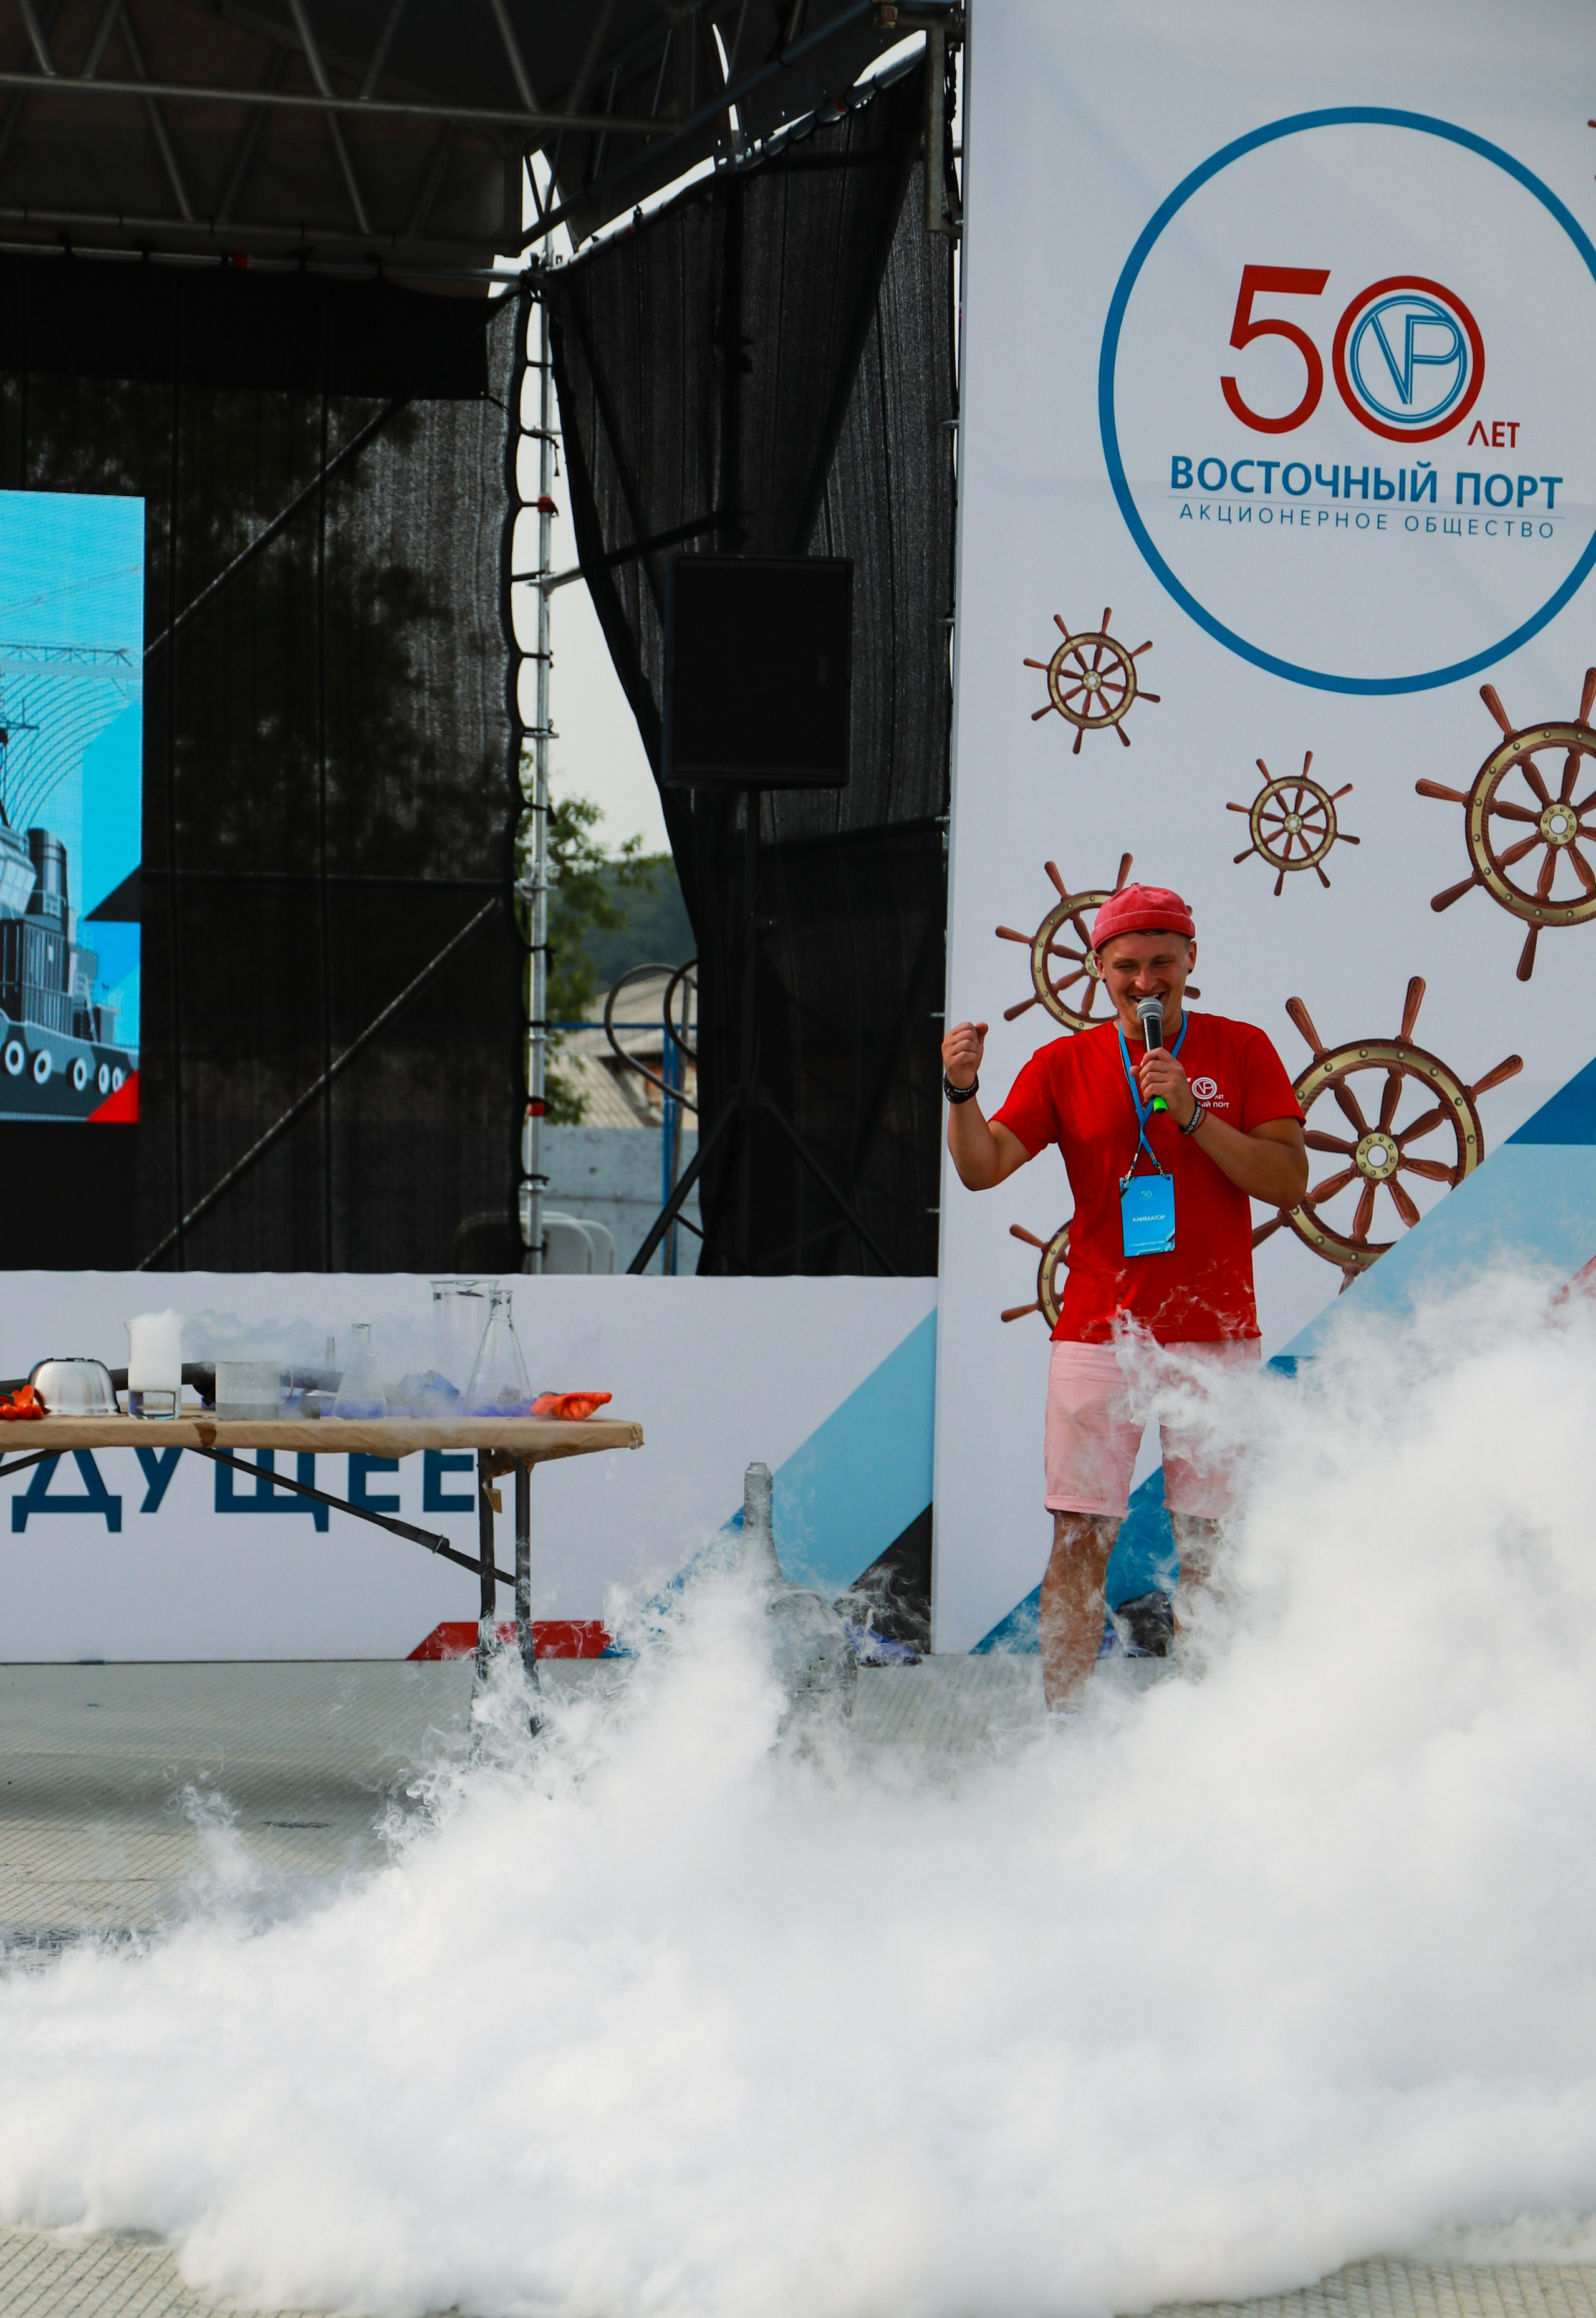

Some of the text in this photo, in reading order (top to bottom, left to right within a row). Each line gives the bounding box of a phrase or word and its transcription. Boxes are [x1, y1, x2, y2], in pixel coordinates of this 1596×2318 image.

[1221, 264, 1520, 448] 50 ЛЕТ
[1171, 455, 1563, 509] ВОСТОЧНЫЙ ПОРТ
[1180, 503, 1554, 539] АКЦИОНЕРНОЕ ОБЩЕСТВО
[1191, 1106, 1201, 1126] КОЛЕНО
[1132, 1214, 1166, 1223] АНИМАТОР
[0, 1447, 476, 1532] ДУЩЕЕ
